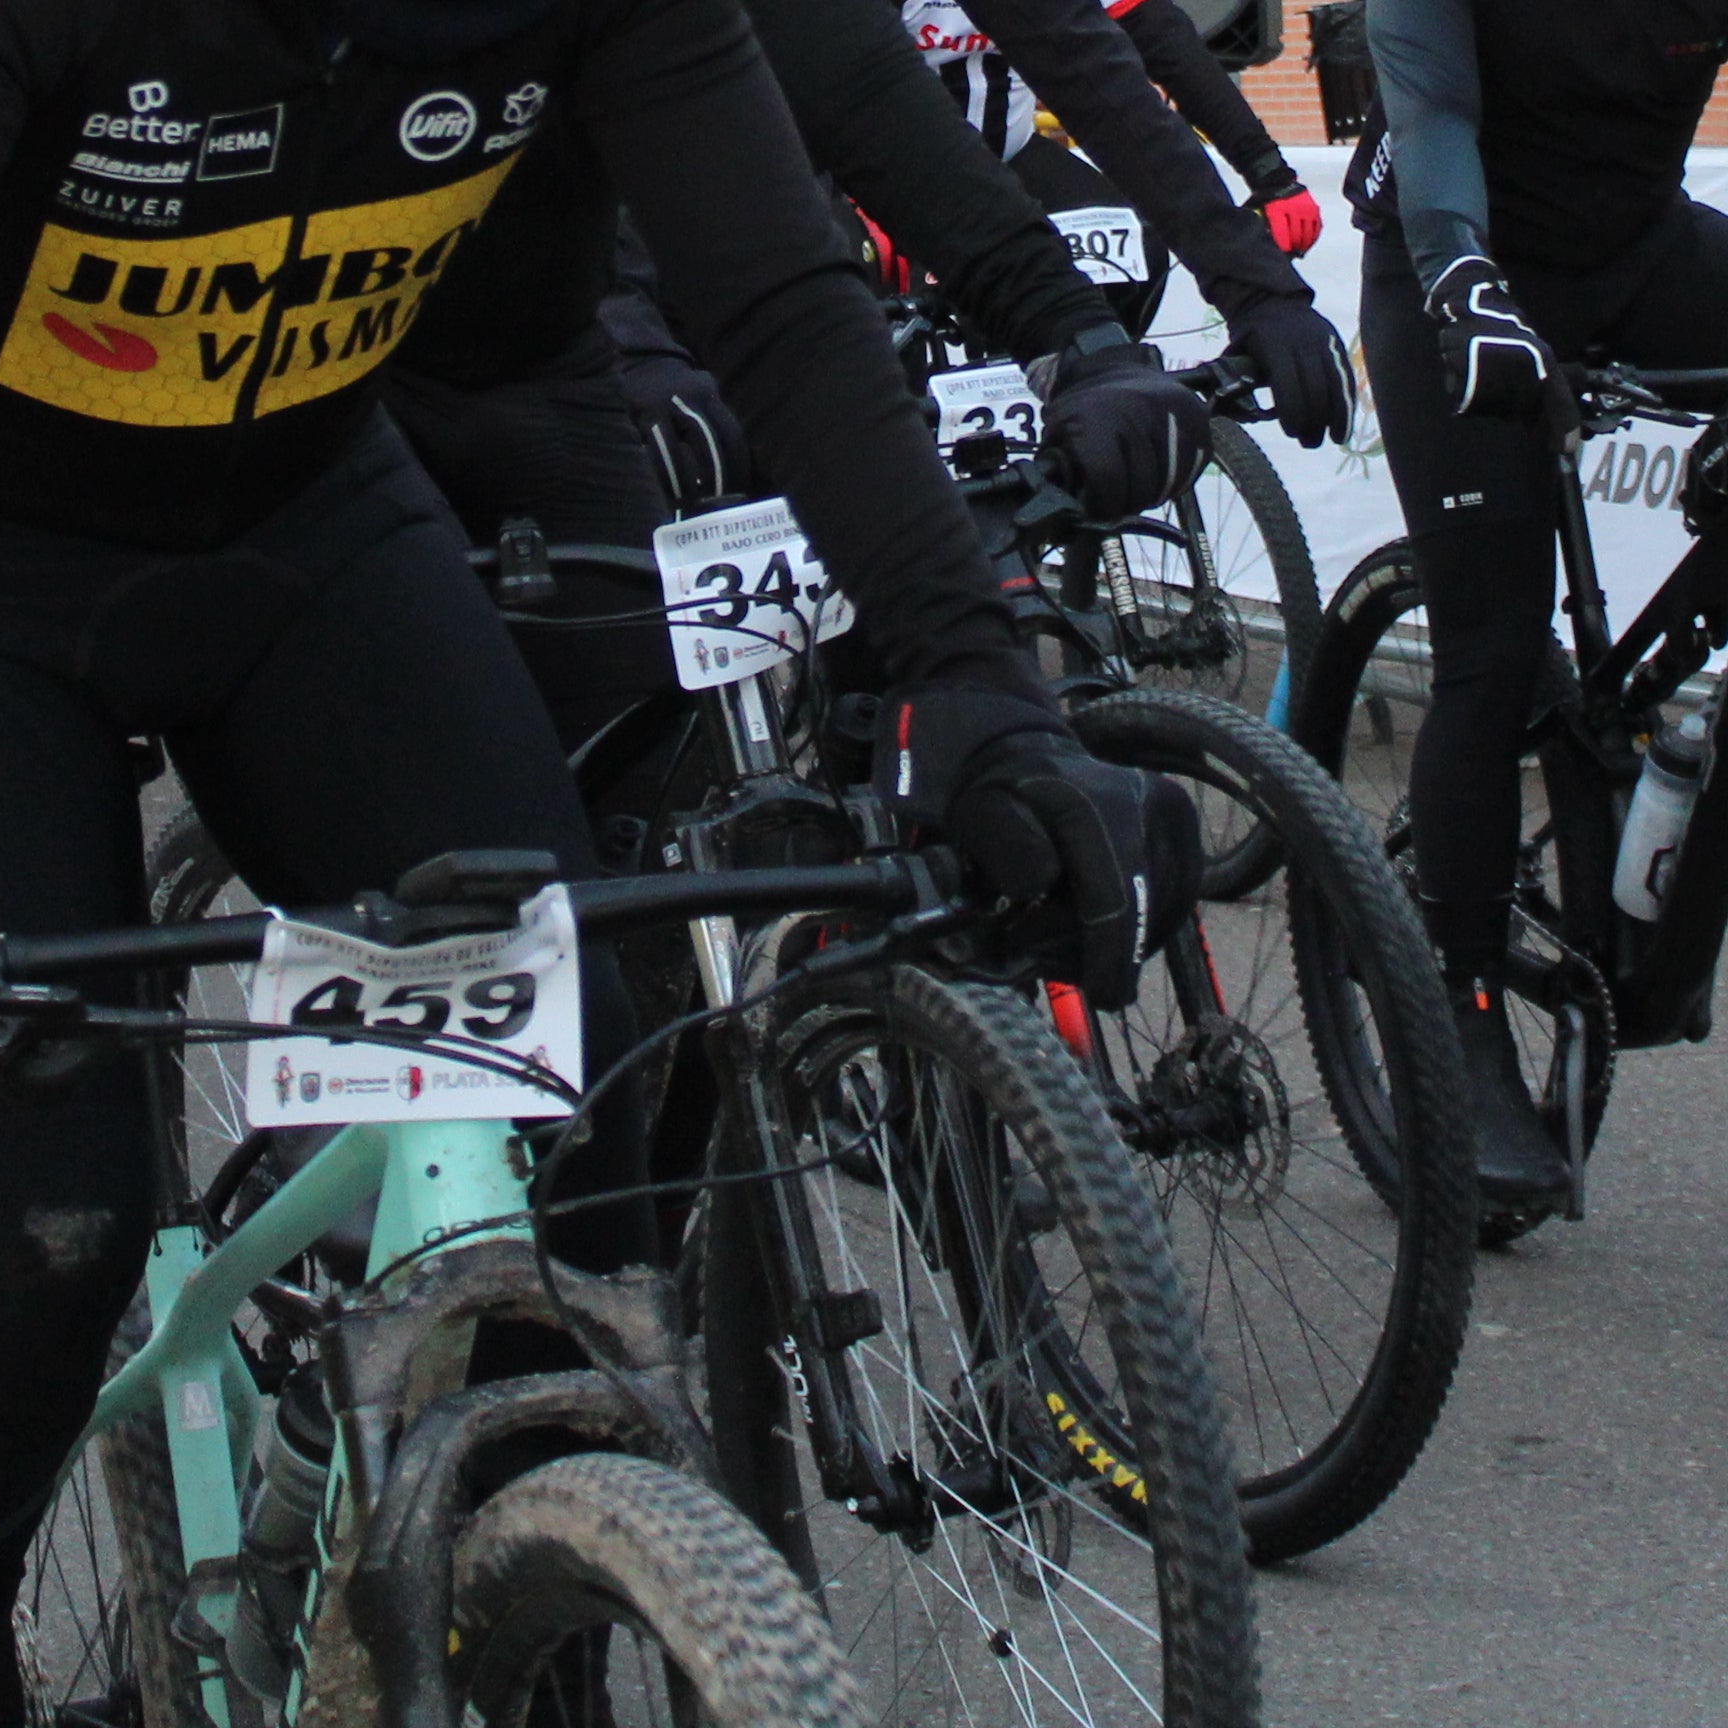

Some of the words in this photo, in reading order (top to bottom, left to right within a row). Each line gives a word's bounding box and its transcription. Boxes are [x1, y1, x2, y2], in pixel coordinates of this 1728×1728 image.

[82, 112, 201, 145] Better
[207, 130, 271, 154] HEMA
[73, 151, 190, 180] Bianchi
[59, 180, 184, 217] ZUIVER
[722, 538, 752, 552] BAJO
[756, 531, 782, 544] CERO
[696, 551, 829, 627] 34
[291, 972, 536, 1041] 459
